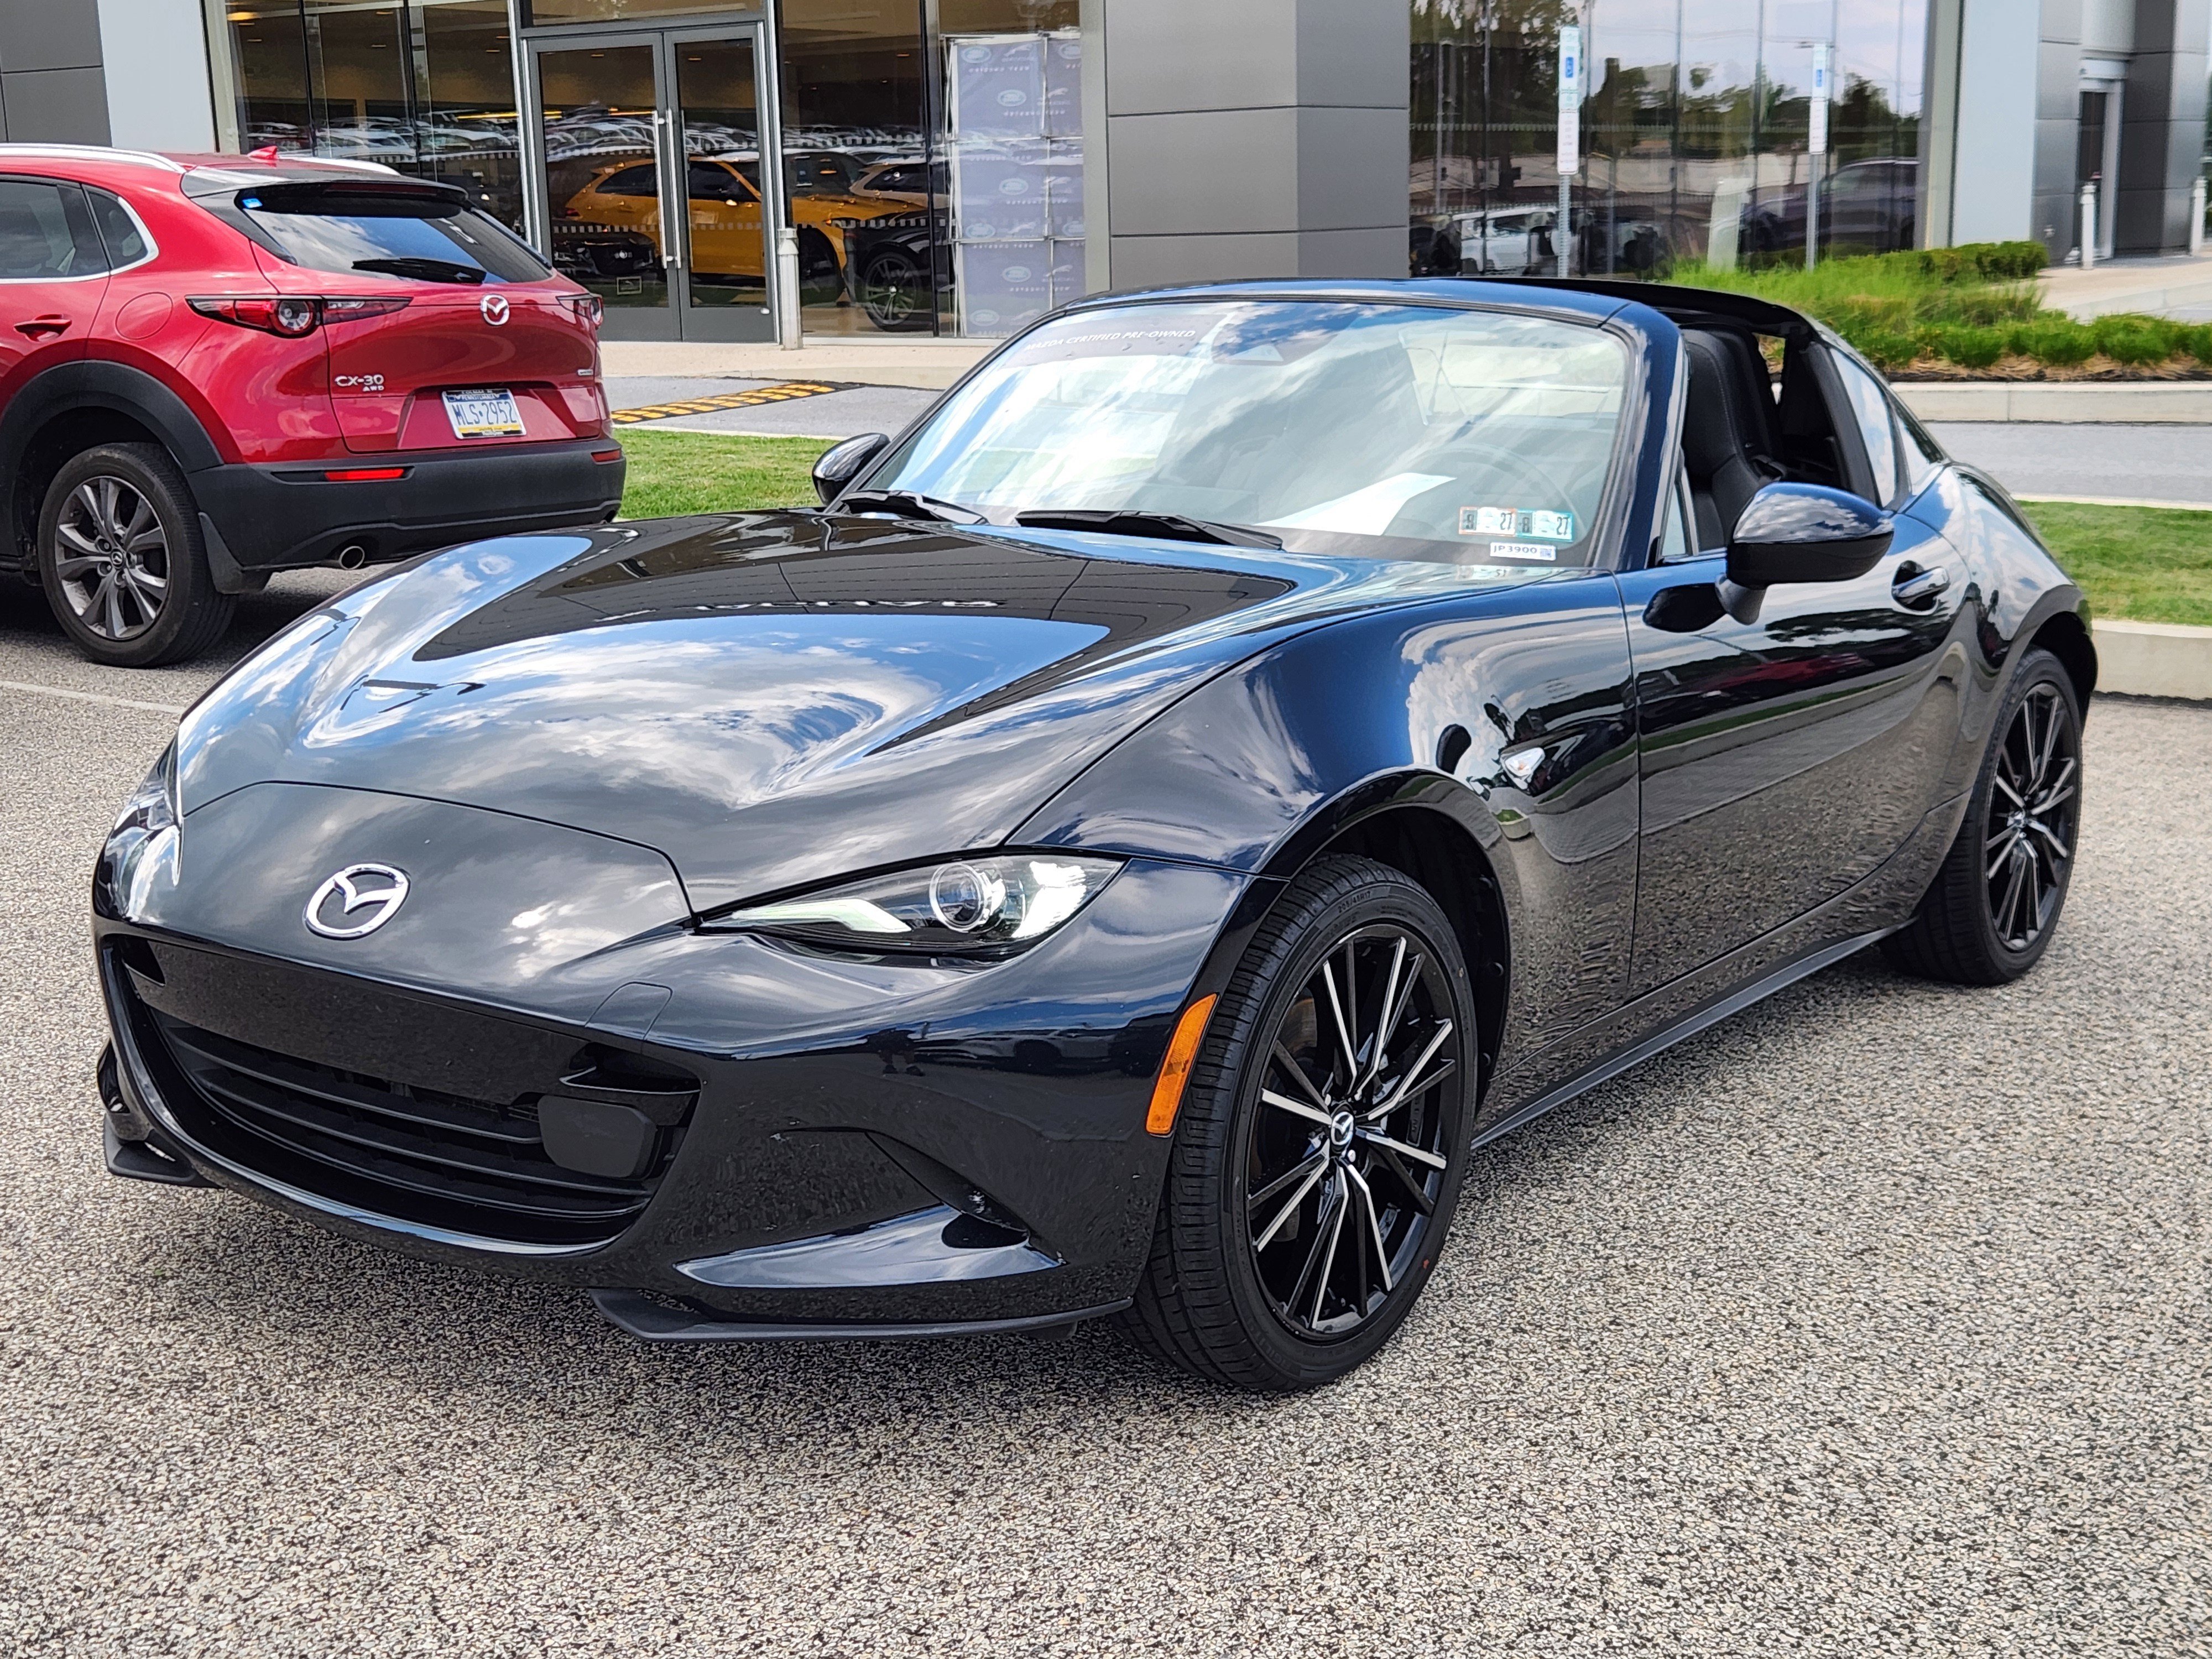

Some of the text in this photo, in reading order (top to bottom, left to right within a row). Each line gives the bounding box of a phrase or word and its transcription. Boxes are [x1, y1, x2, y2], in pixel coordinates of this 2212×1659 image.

[1024, 330, 1196, 351] MAZDA CERTIFIED PRE-OWNED
[335, 374, 384, 387] CX-30
[1500, 512, 1512, 530] 27
[1557, 517, 1570, 535] 27
[1494, 545, 1537, 554] JP3900
